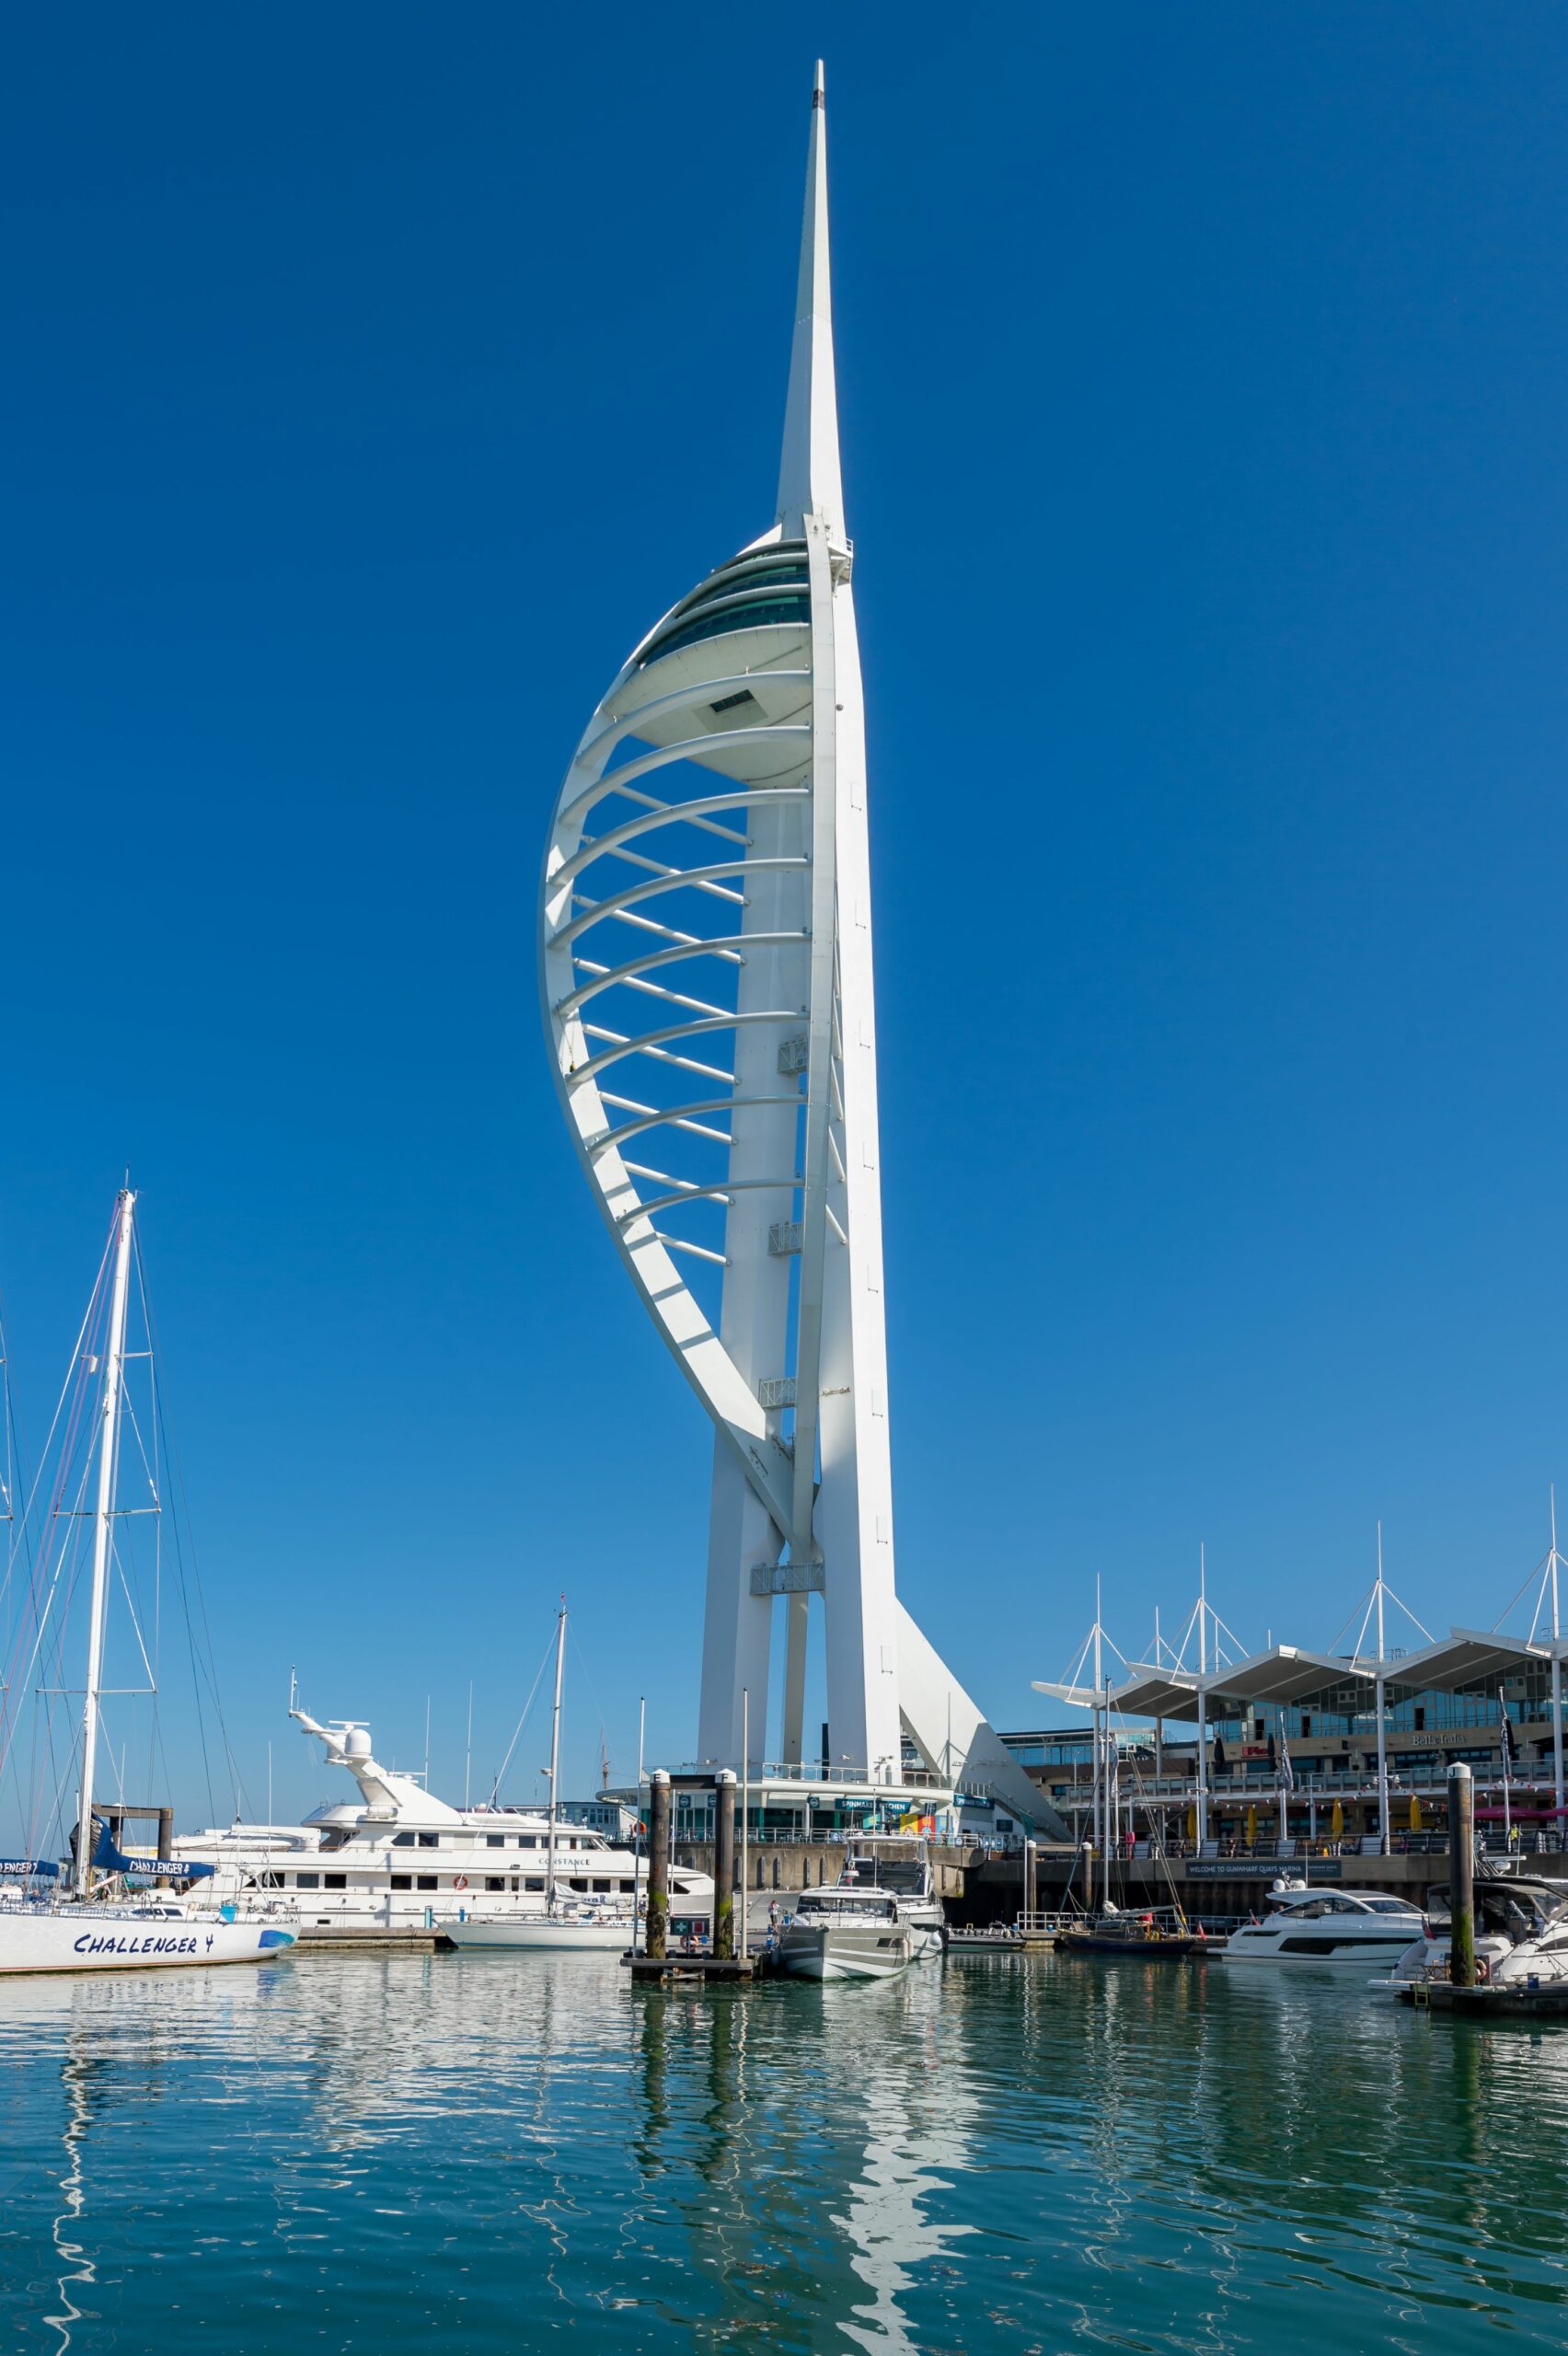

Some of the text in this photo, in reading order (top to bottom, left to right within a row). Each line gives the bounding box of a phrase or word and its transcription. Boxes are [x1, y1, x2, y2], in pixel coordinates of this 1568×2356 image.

[1412, 1733, 1466, 1746] Bella Italia
[1448, 1767, 1456, 1777] J
[653, 1773, 661, 1783] E
[721, 1773, 729, 1783] F
[538, 1857, 591, 1865] CONSTANCE
[129, 1860, 190, 1874] CHALLENGER 4
[1259, 1865, 1278, 1874] QUAYS
[74, 1934, 214, 1954] CHALLENGER 4
